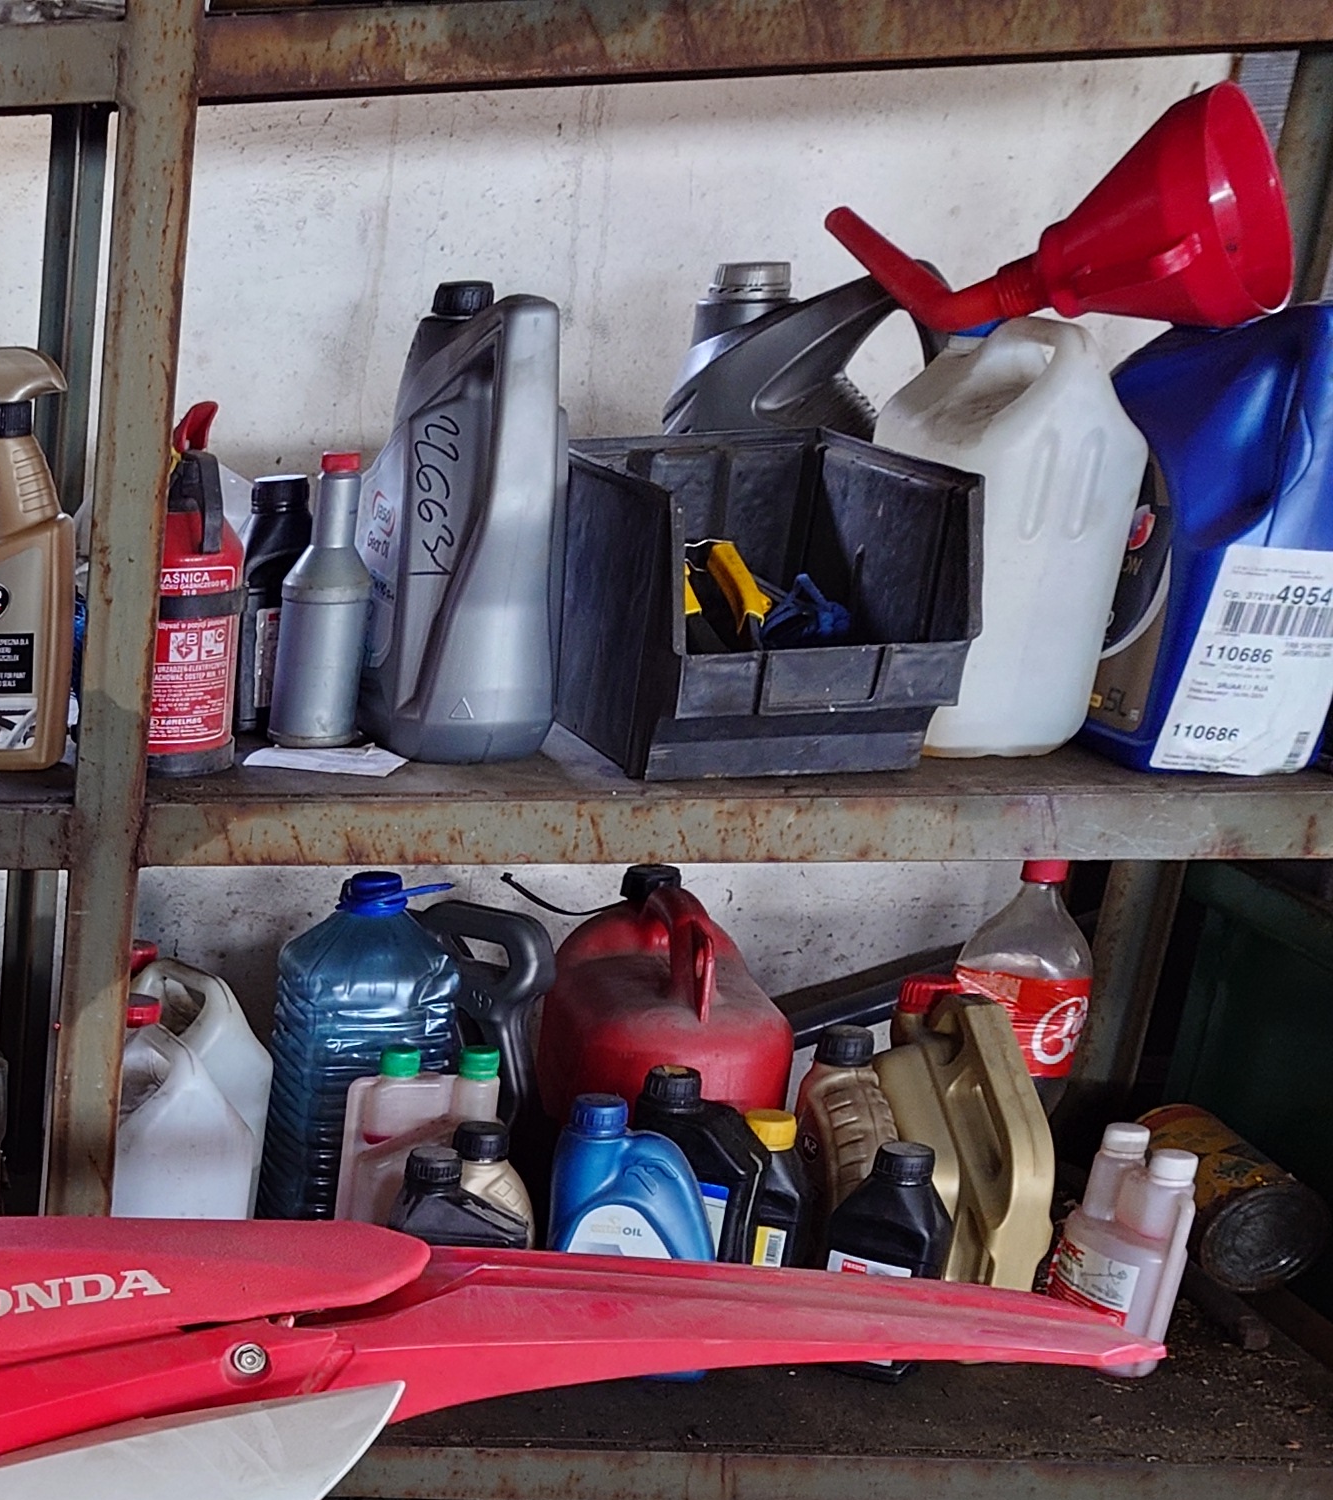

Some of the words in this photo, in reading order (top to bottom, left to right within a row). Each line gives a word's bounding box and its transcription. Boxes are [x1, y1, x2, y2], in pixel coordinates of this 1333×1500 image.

[367, 531, 382, 551] Gear
[161, 571, 210, 584] AŚNICA
[187, 632, 198, 645] B
[215, 629, 225, 641] C
[1205, 644, 1274, 664] 110686
[1172, 723, 1240, 742] 110686
[622, 1226, 643, 1237] OIL
